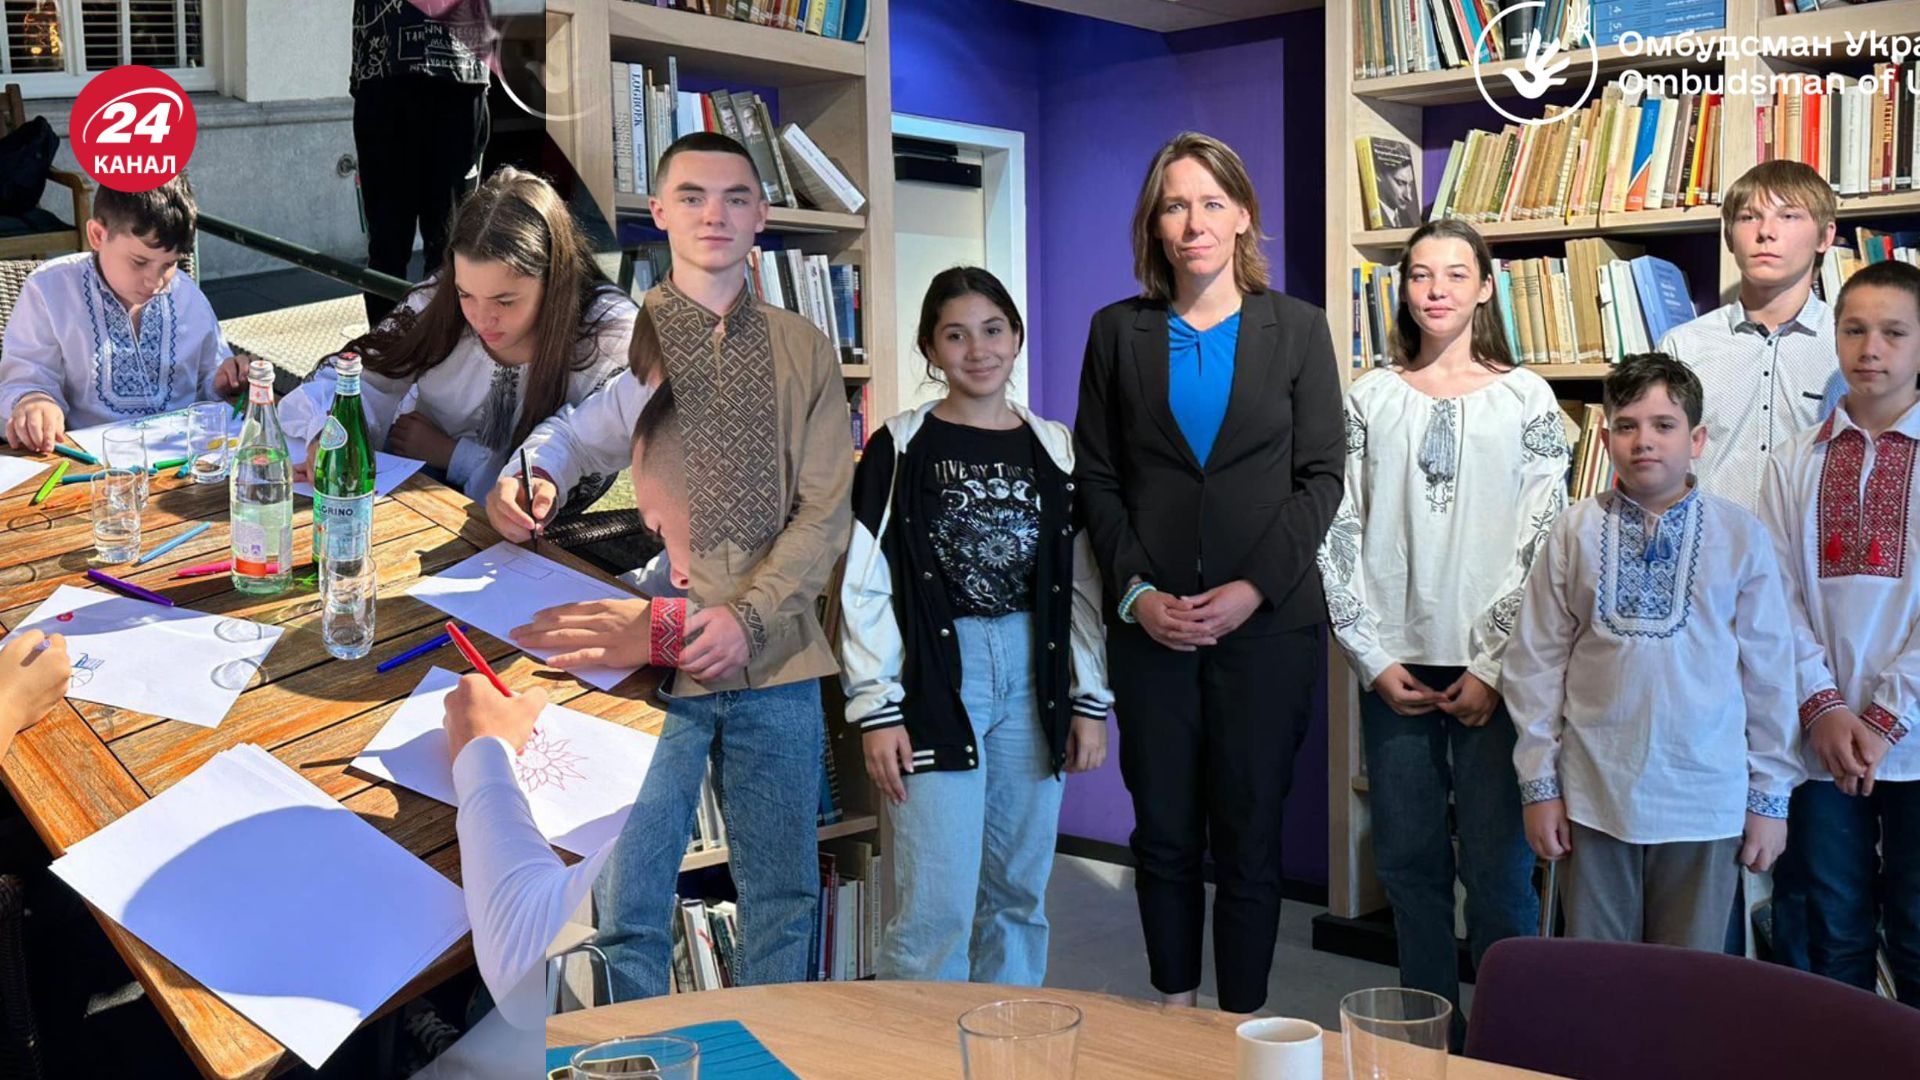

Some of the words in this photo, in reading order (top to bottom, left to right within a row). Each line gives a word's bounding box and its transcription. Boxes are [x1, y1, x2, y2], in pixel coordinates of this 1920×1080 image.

[934, 459, 968, 484] LIVE
[970, 464, 988, 479] BY
[319, 504, 354, 517] GRINO
